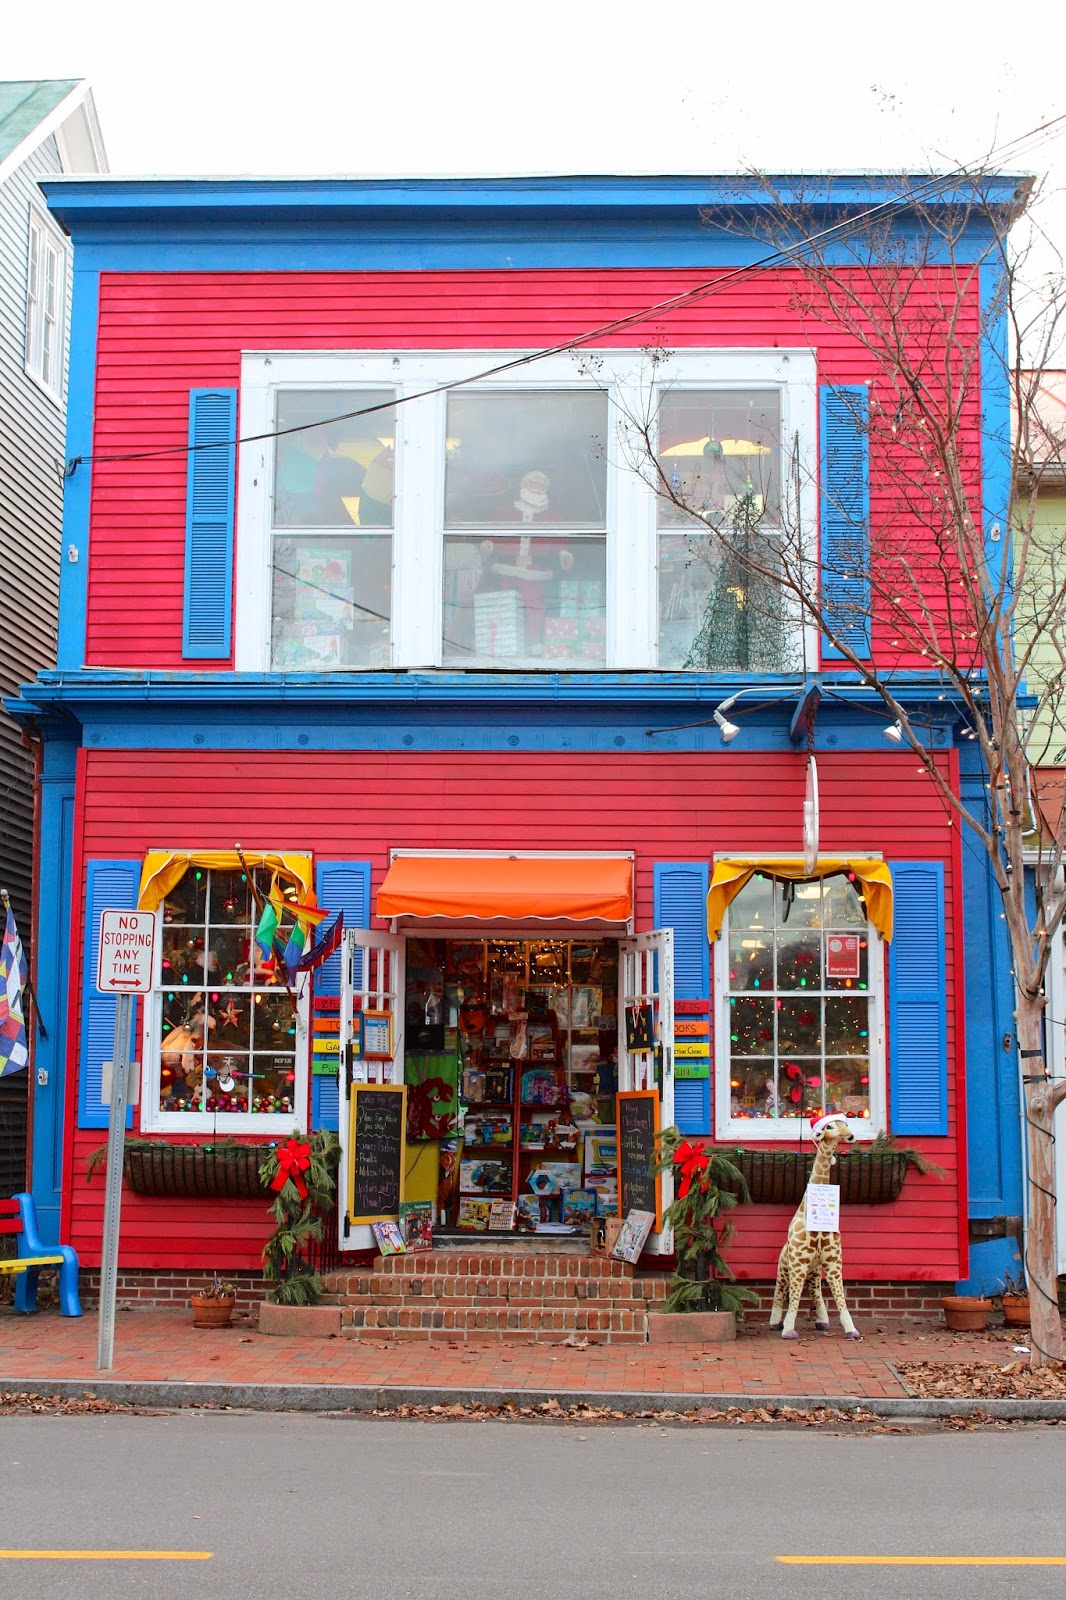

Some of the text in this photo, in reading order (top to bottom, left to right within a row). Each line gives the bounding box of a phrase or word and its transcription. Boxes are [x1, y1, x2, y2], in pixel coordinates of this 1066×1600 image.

[118, 917, 138, 929] NO
[104, 932, 152, 947] STOPPING
[114, 949, 140, 960] ANY
[112, 963, 140, 974] TIME
[674, 1003, 700, 1012] RAFTS
[674, 1025, 697, 1033] OOKS
